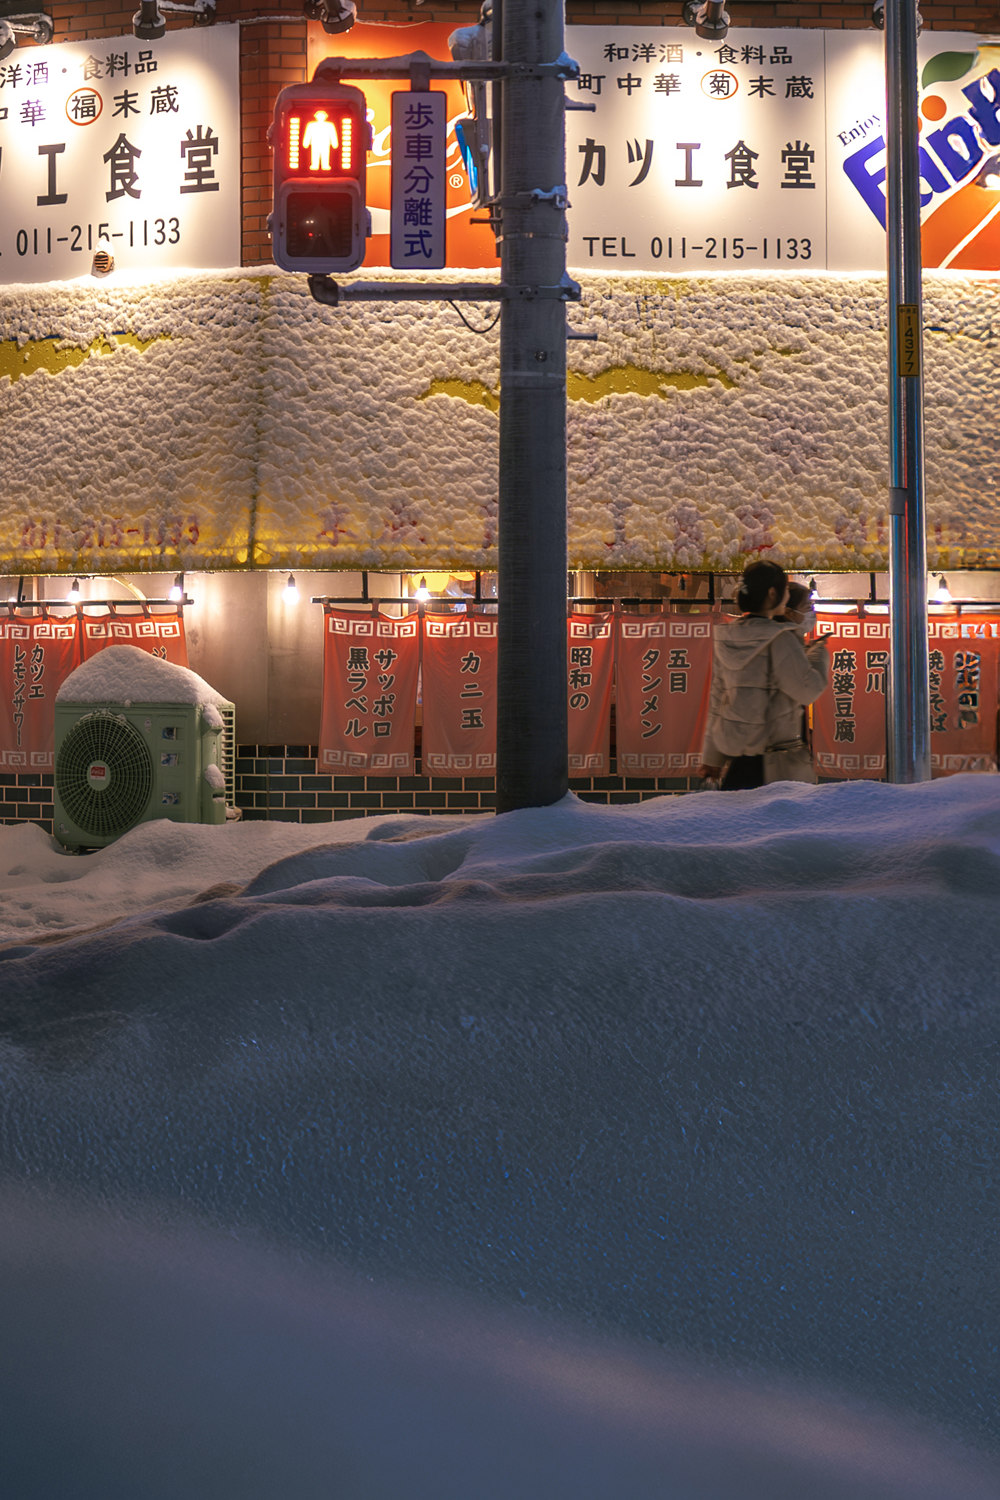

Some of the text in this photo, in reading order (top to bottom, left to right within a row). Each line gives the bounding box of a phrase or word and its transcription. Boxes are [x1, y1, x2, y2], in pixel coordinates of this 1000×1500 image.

[603, 42, 793, 65] 和洋酒・食料品
[577, 72, 681, 96] 町中華
[403, 102, 434, 259] 歩車分離式
[577, 137, 816, 190] カツエ食堂
[16, 217, 182, 257] 011-215-1133
[582, 236, 812, 260] TEL 011-215-1133
[904, 316, 914, 372] 14377
[13, 644, 27, 746] レモンサワー
[28, 643, 45, 699] カツエ
[345, 647, 370, 738] 黒ラベル
[372, 649, 397, 738] サッポロ
[460, 651, 484, 729] カニ玉
[569, 645, 593, 710] 昭和の
[640, 649, 662, 739] タンメン
[667, 649, 690, 694] 五目
[832, 649, 857, 743] 麻婆豆腐
[865, 651, 888, 694] 四川
